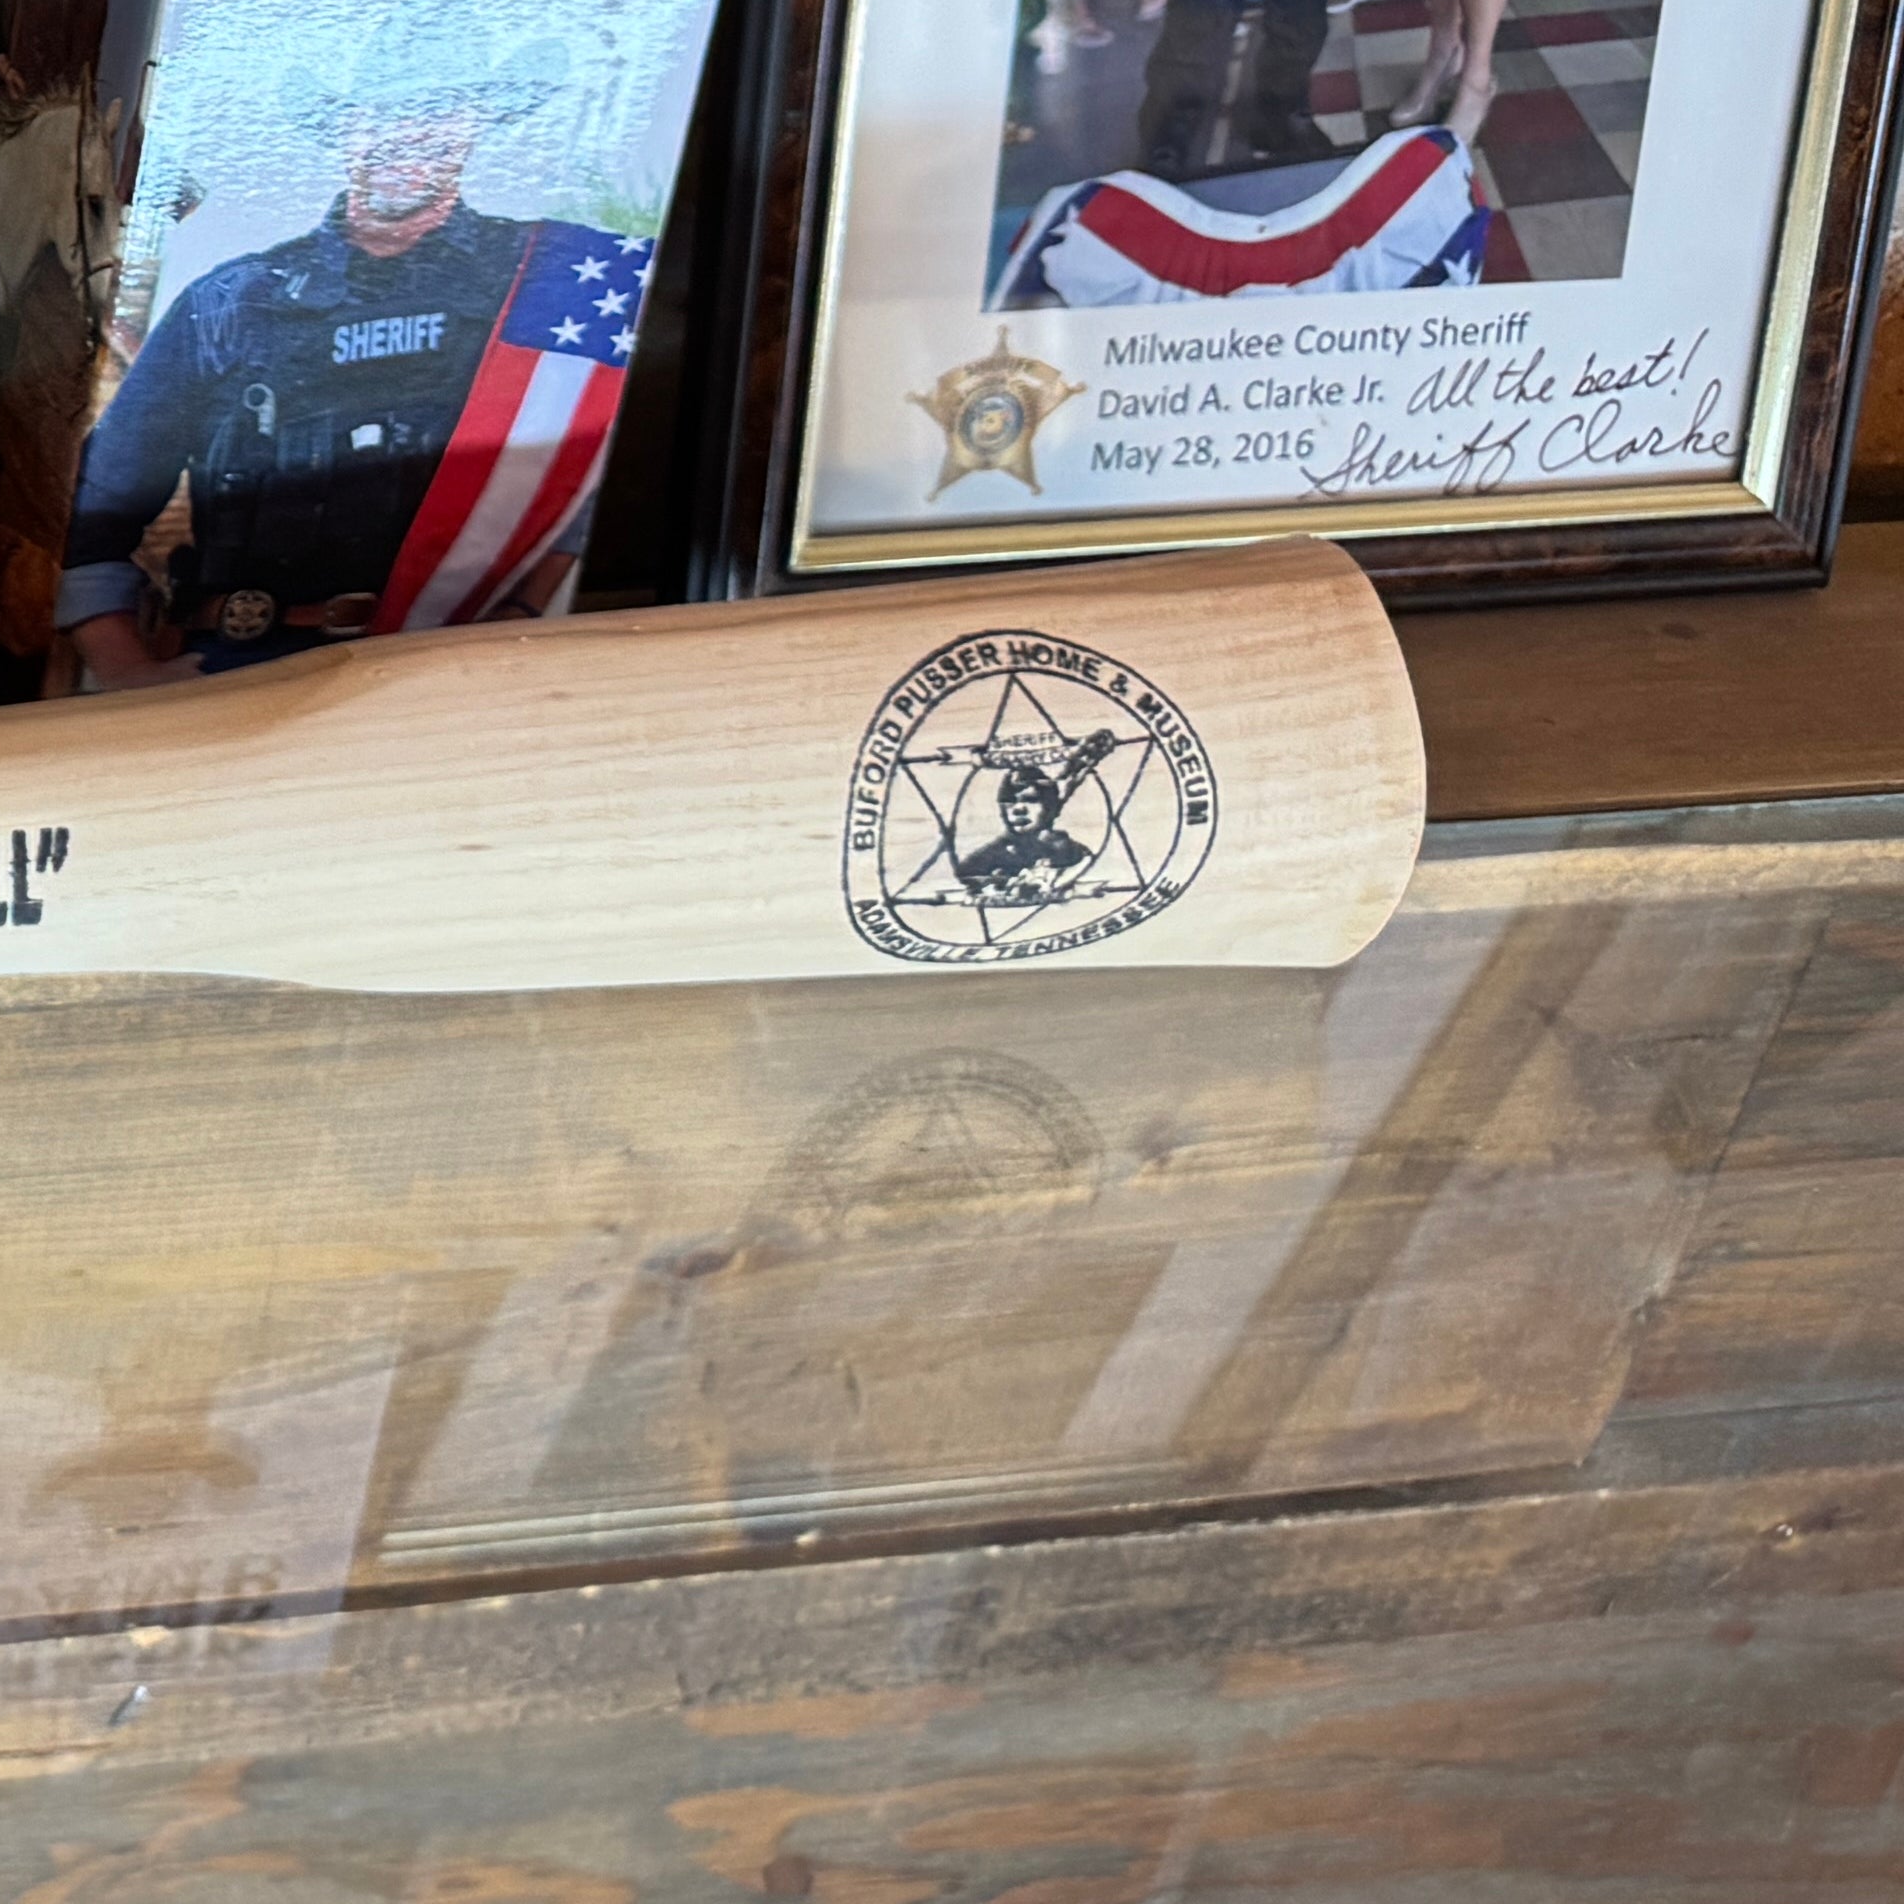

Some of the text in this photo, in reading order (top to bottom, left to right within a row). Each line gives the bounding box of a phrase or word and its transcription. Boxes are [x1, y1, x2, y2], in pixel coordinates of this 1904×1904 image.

[332, 312, 445, 364] SHERIFF
[1104, 312, 1531, 367] Milwaukee County Sheriff
[1495, 346, 1554, 403] the
[1573, 328, 1709, 398] best!
[1097, 375, 1384, 419] David A. Clarke Jr.
[1091, 428, 1315, 473] May 28, 2016
[1298, 378, 1740, 498] Sheriff Clarke
[853, 640, 1209, 852] BUFORD PUSSER HOME & MUSEUM
[994, 876, 1181, 958] TENNESSEE
